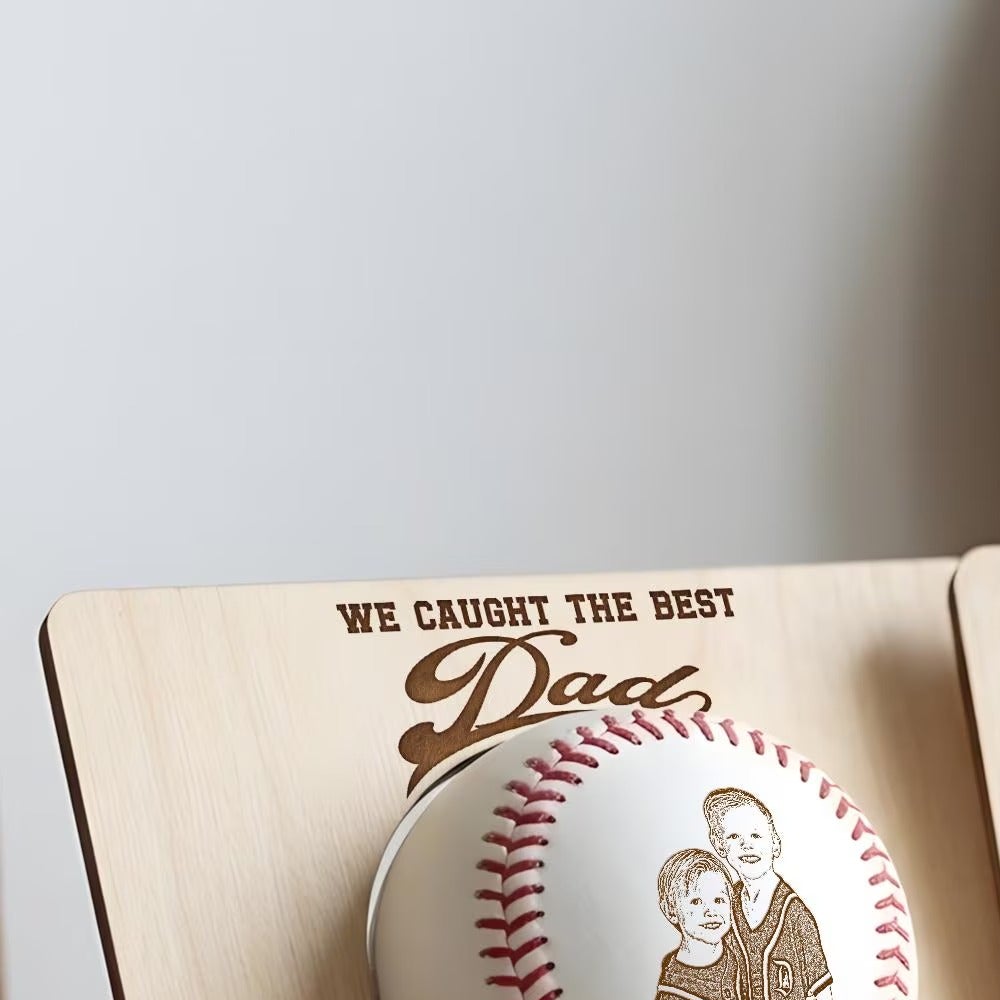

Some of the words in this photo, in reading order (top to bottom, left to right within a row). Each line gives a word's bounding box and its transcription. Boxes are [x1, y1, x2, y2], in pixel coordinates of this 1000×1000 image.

[336, 602, 401, 634] WE
[413, 596, 549, 631] CAUGHT
[565, 591, 638, 624] THE
[649, 587, 735, 620] BEST
[397, 629, 712, 798] Dad
